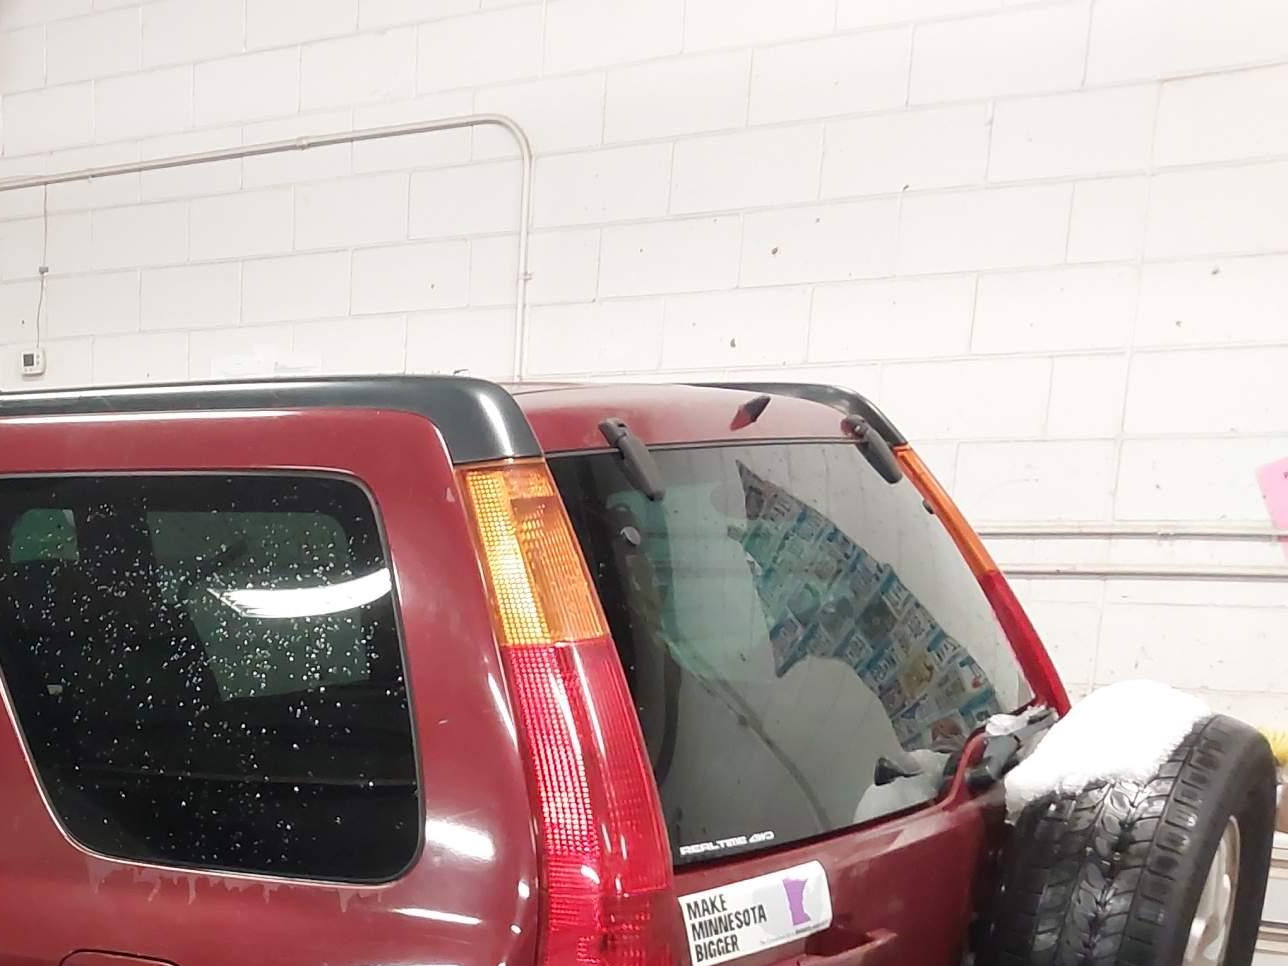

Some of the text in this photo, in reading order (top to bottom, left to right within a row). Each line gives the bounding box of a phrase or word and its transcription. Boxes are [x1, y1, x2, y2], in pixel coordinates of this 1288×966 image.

[686, 893, 727, 921] MAKE
[691, 903, 768, 942] MINNESOTA
[694, 933, 740, 963] BIGGER
